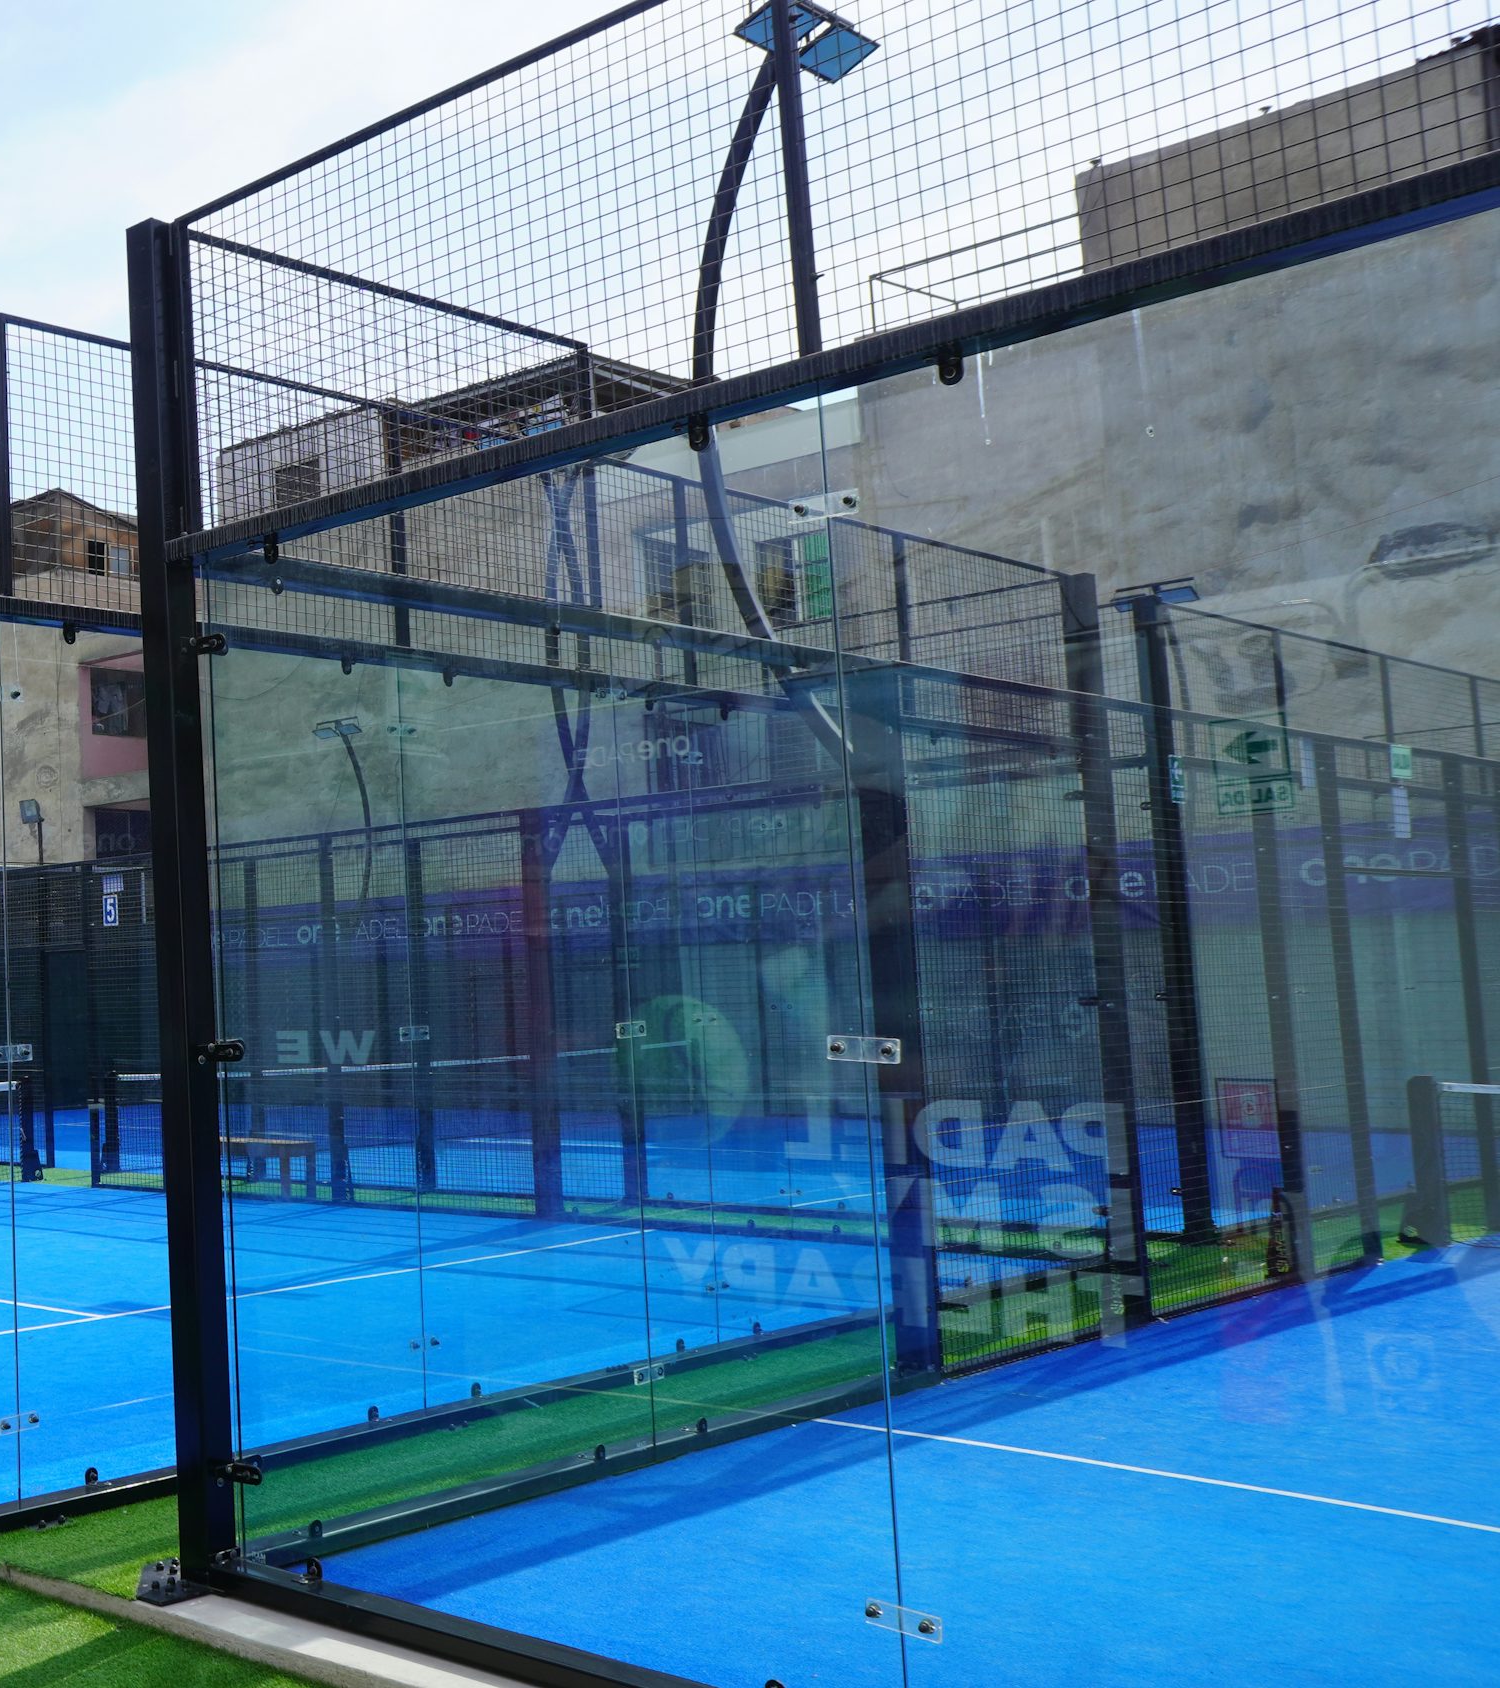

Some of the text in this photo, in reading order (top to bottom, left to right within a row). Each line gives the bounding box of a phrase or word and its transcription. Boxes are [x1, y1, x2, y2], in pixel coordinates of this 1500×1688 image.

[105, 897, 116, 924] 5
[466, 910, 524, 935] PADE
[697, 895, 752, 919] one
